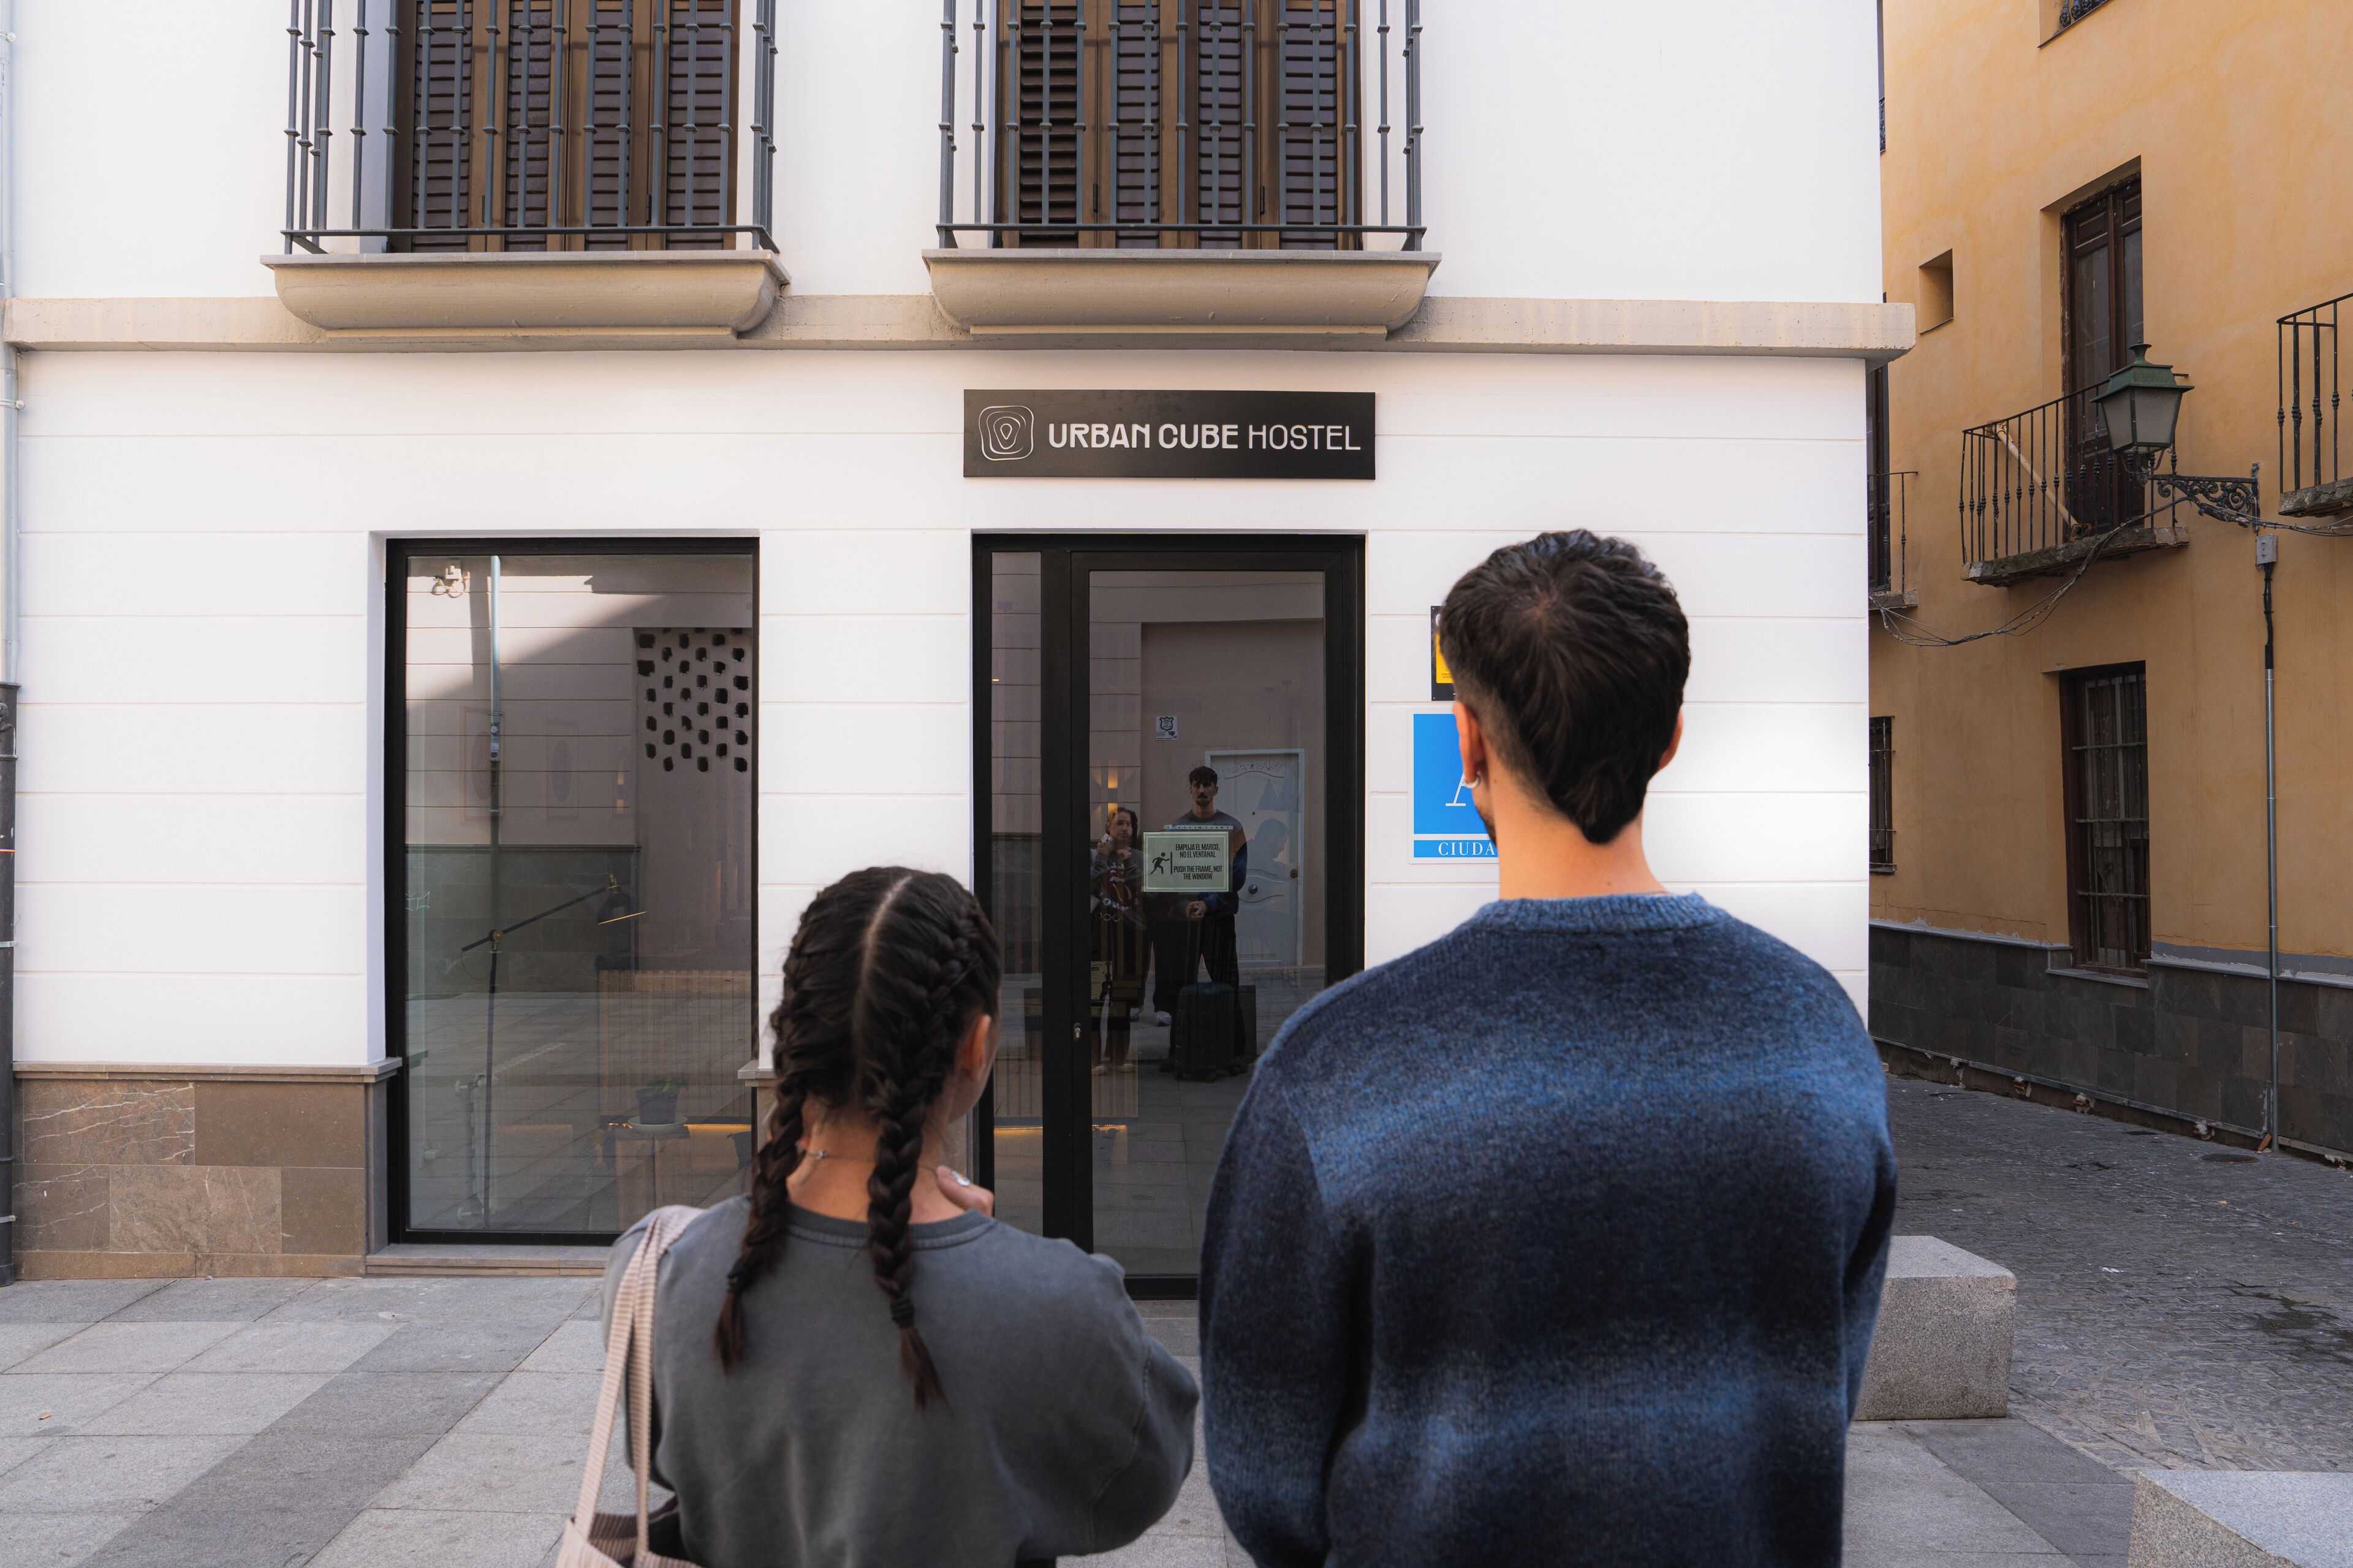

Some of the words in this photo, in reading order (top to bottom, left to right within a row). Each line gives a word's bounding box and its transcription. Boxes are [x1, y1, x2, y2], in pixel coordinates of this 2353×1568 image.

[1048, 423, 1150, 449] URBAN
[1158, 423, 1238, 449] CUBE
[1249, 425, 1362, 450] HOSTEL
[1438, 842, 1495, 855] CIUDA
